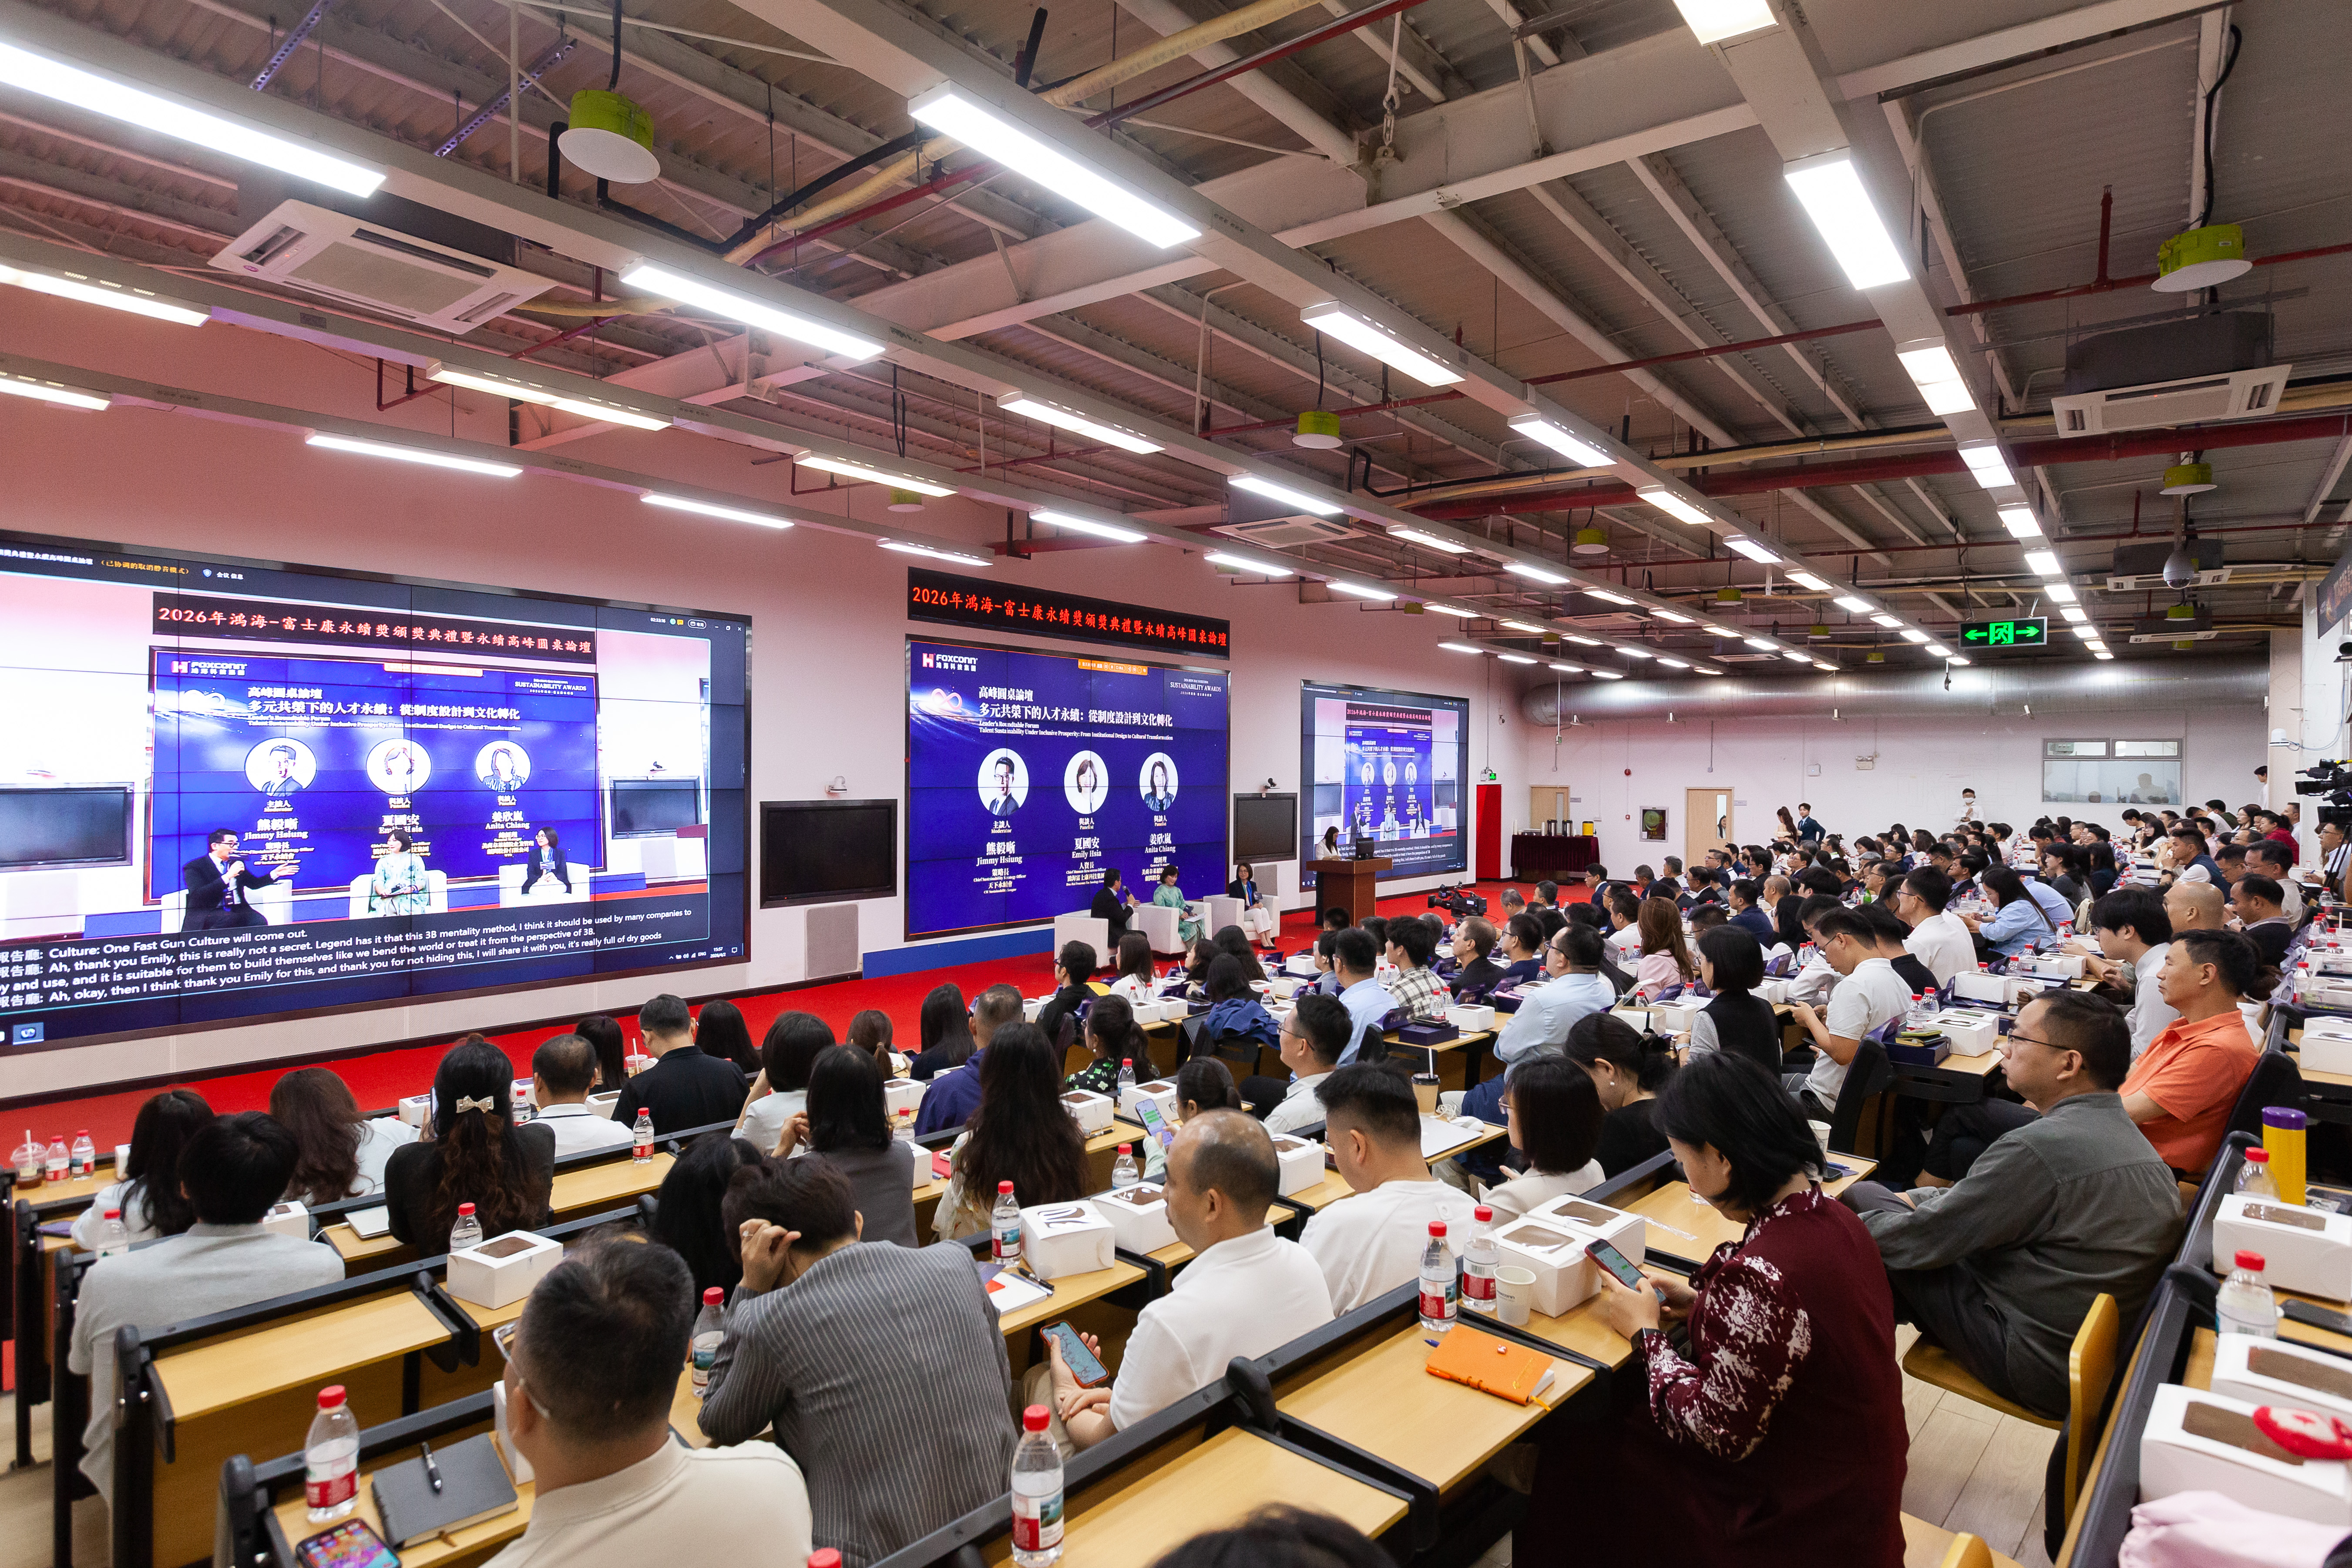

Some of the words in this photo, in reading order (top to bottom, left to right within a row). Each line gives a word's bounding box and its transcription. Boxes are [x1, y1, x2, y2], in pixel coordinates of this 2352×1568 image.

[913, 587, 1227, 646] 2026年鴻海-富士康永續獎頒獎典禮暨永續高峰圓桌論壇
[514, 681, 562, 691] SUSTAINABILITY
[1170, 682, 1204, 691] SUSTAINABILITY
[979, 685, 1034, 702] 高峰圓桌論壇
[995, 728, 1025, 736] Sustainability
[243, 832, 275, 841] Jimmy
[276, 830, 309, 839] Hsiung
[1074, 836, 1100, 850] 夏國安
[976, 857, 999, 866] Jimmy
[999, 855, 1023, 864] Hsiung
[1072, 850, 1089, 860] Emily
[49, 962, 71, 973] Ah,
[74, 958, 111, 970] thank
[113, 958, 137, 970] you
[141, 954, 176, 965] Emily,
[179, 951, 201, 961] this
[204, 950, 213, 959] is
[215, 947, 246, 958] really
[249, 945, 268, 955] not
[279, 942, 313, 952] secret.
[316, 937, 353, 950] Legend
[355, 937, 373, 945] has
[375, 935, 382, 943] it
[383, 934, 403, 942] that
[405, 932, 423, 941] this
[425, 930, 437, 939] 3B
[440, 927, 480, 937] mentality
[482, 923, 517, 933] method,
[524, 921, 545, 930] think
[554, 918, 581, 927] should
[595, 915, 612, 923] used
[614, 915, 623, 924] by
[646, 910, 683, 920] companies
[49, 947, 100, 958] Culture:
[103, 944, 130, 954] One
[134, 941, 158, 951] Fast
[160, 940, 185, 949] Gun
[188, 937, 231, 947] Culture
[233, 933, 252, 943] will
[254, 933, 285, 941] come
[287, 930, 308, 938] out.
[13, 978, 39, 991] and
[43, 979, 69, 988] use,
[72, 974, 97, 985] and
[101, 973, 110, 982] it
[113, 972, 123, 981] is
[126, 967, 174, 980] suitable
[176, 965, 195, 975] for
[196, 964, 227, 973] them
[245, 957, 272, 968] build
[274, 953, 333, 965] themselves
[336, 950, 353, 960] like
[373, 945, 397, 956] bend
[399, 945, 416, 953] the
[418, 941, 444, 952] world
[457, 938, 478, 948] treat
[488, 937, 509, 945] from
[510, 934, 524, 943] the
[527, 930, 571, 943] perspective
[573, 928, 582, 937] of
[49, 990, 71, 1002] Ah,
[74, 988, 108, 1000] okay,
[111, 985, 140, 995] then
[143, 983, 147, 992] I
[150, 980, 182, 991] think
[184, 976, 217, 988] thank
[219, 976, 241, 987] you
[244, 970, 274, 982] Emily
[276, 969, 292, 978] for
[293, 967, 315, 977] this,
[318, 964, 337, 974] and
[339, 961, 368, 972] thank
[370, 961, 388, 971] you
[390, 958, 405, 966] for
[407, 956, 424, 965] not
[426, 953, 455, 963] hiding
[456, 951, 474, 959] this,
[481, 948, 496, 957] will
[498, 947, 521, 956] share
[530, 943, 548, 952] with
[549, 943, 566, 952] you,
[568, 940, 580, 948] it's
[581, 938, 602, 947] really
[603, 936, 615, 944] full
[617, 935, 625, 943] of
[626, 934, 639, 943] dry
[640, 931, 662, 943] goods
